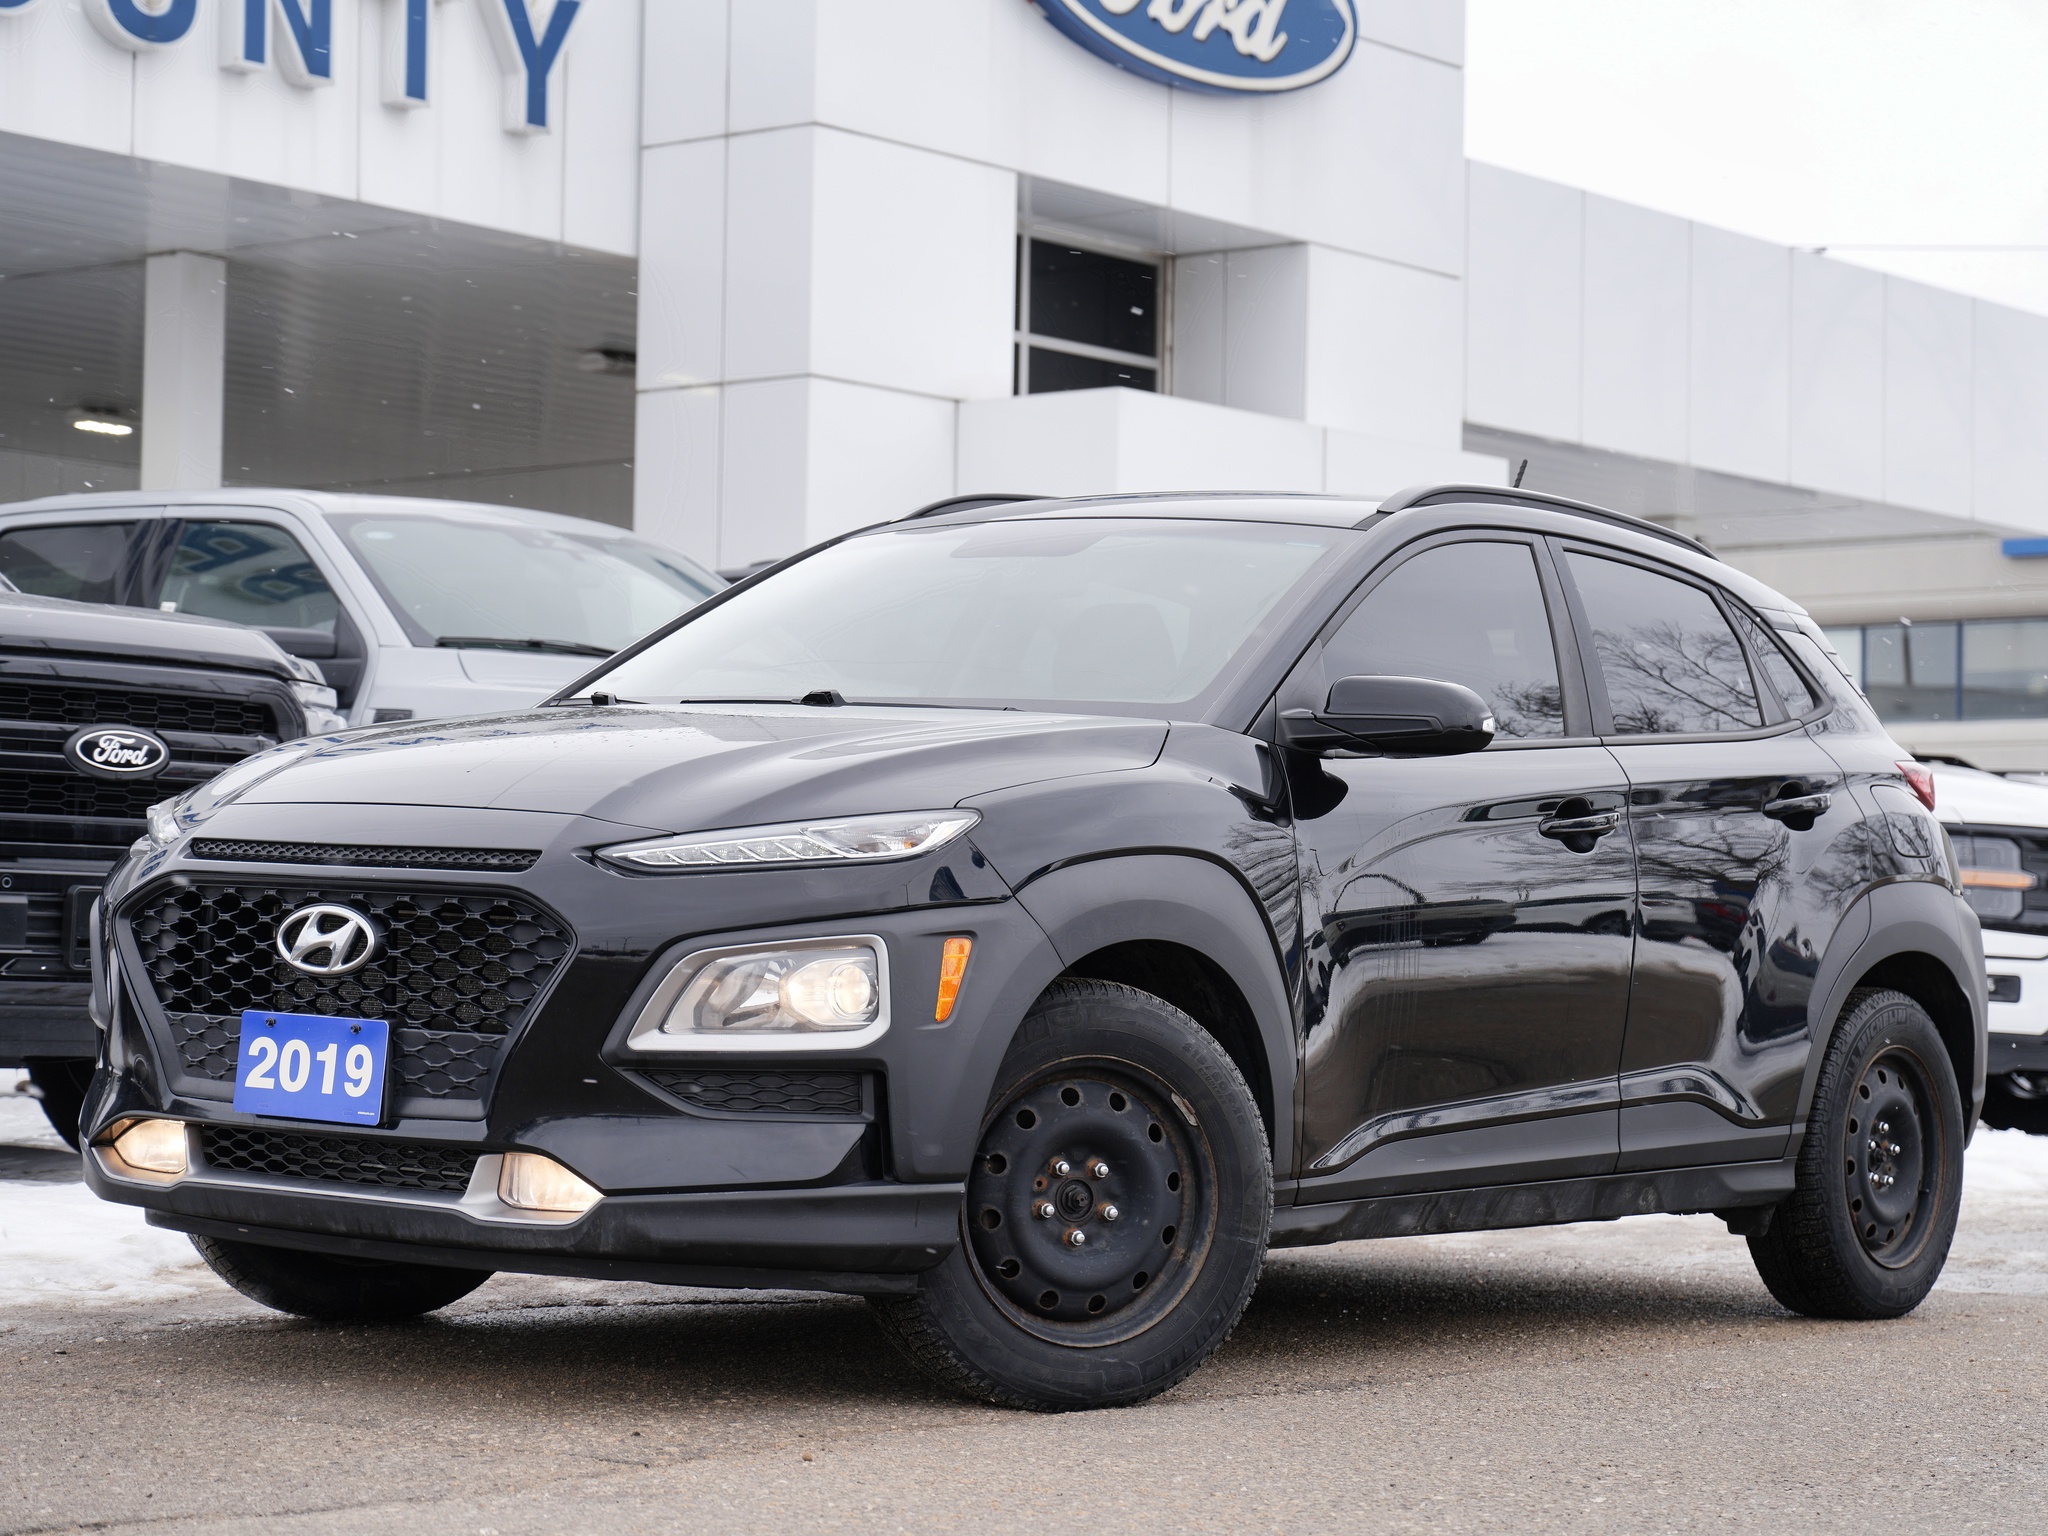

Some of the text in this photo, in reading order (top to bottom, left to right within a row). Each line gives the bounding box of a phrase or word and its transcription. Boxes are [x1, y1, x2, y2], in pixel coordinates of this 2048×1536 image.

[1099, 0, 1288, 62] ord
[93, 735, 149, 765] Ford
[1858, 1008, 1906, 1057] MICHELIN
[244, 1036, 373, 1098] 2019
